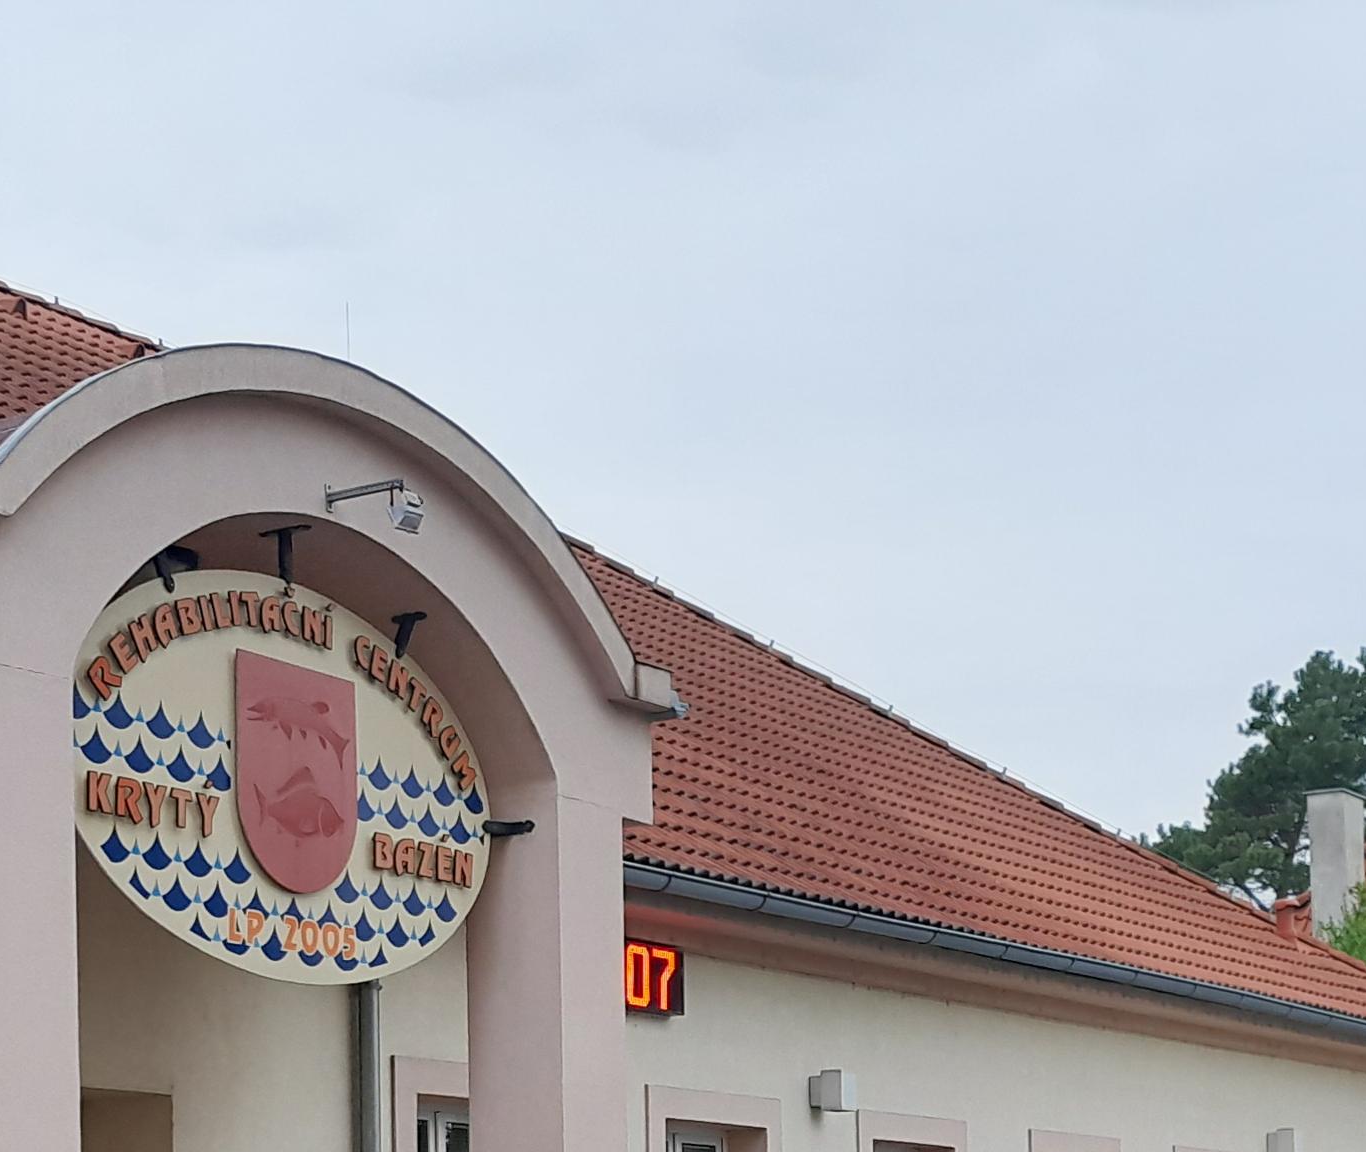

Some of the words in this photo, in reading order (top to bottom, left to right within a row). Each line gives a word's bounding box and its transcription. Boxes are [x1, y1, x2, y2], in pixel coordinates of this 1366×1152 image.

[87, 585, 334, 700] REHABILITAČNÍ
[353, 634, 477, 791] CENTRUM
[86, 770, 220, 837] KRYTÝ
[372, 832, 474, 889] BAZÉN
[227, 908, 265, 943] LP
[283, 916, 357, 959] 2005
[626, 944, 676, 1011] 07
